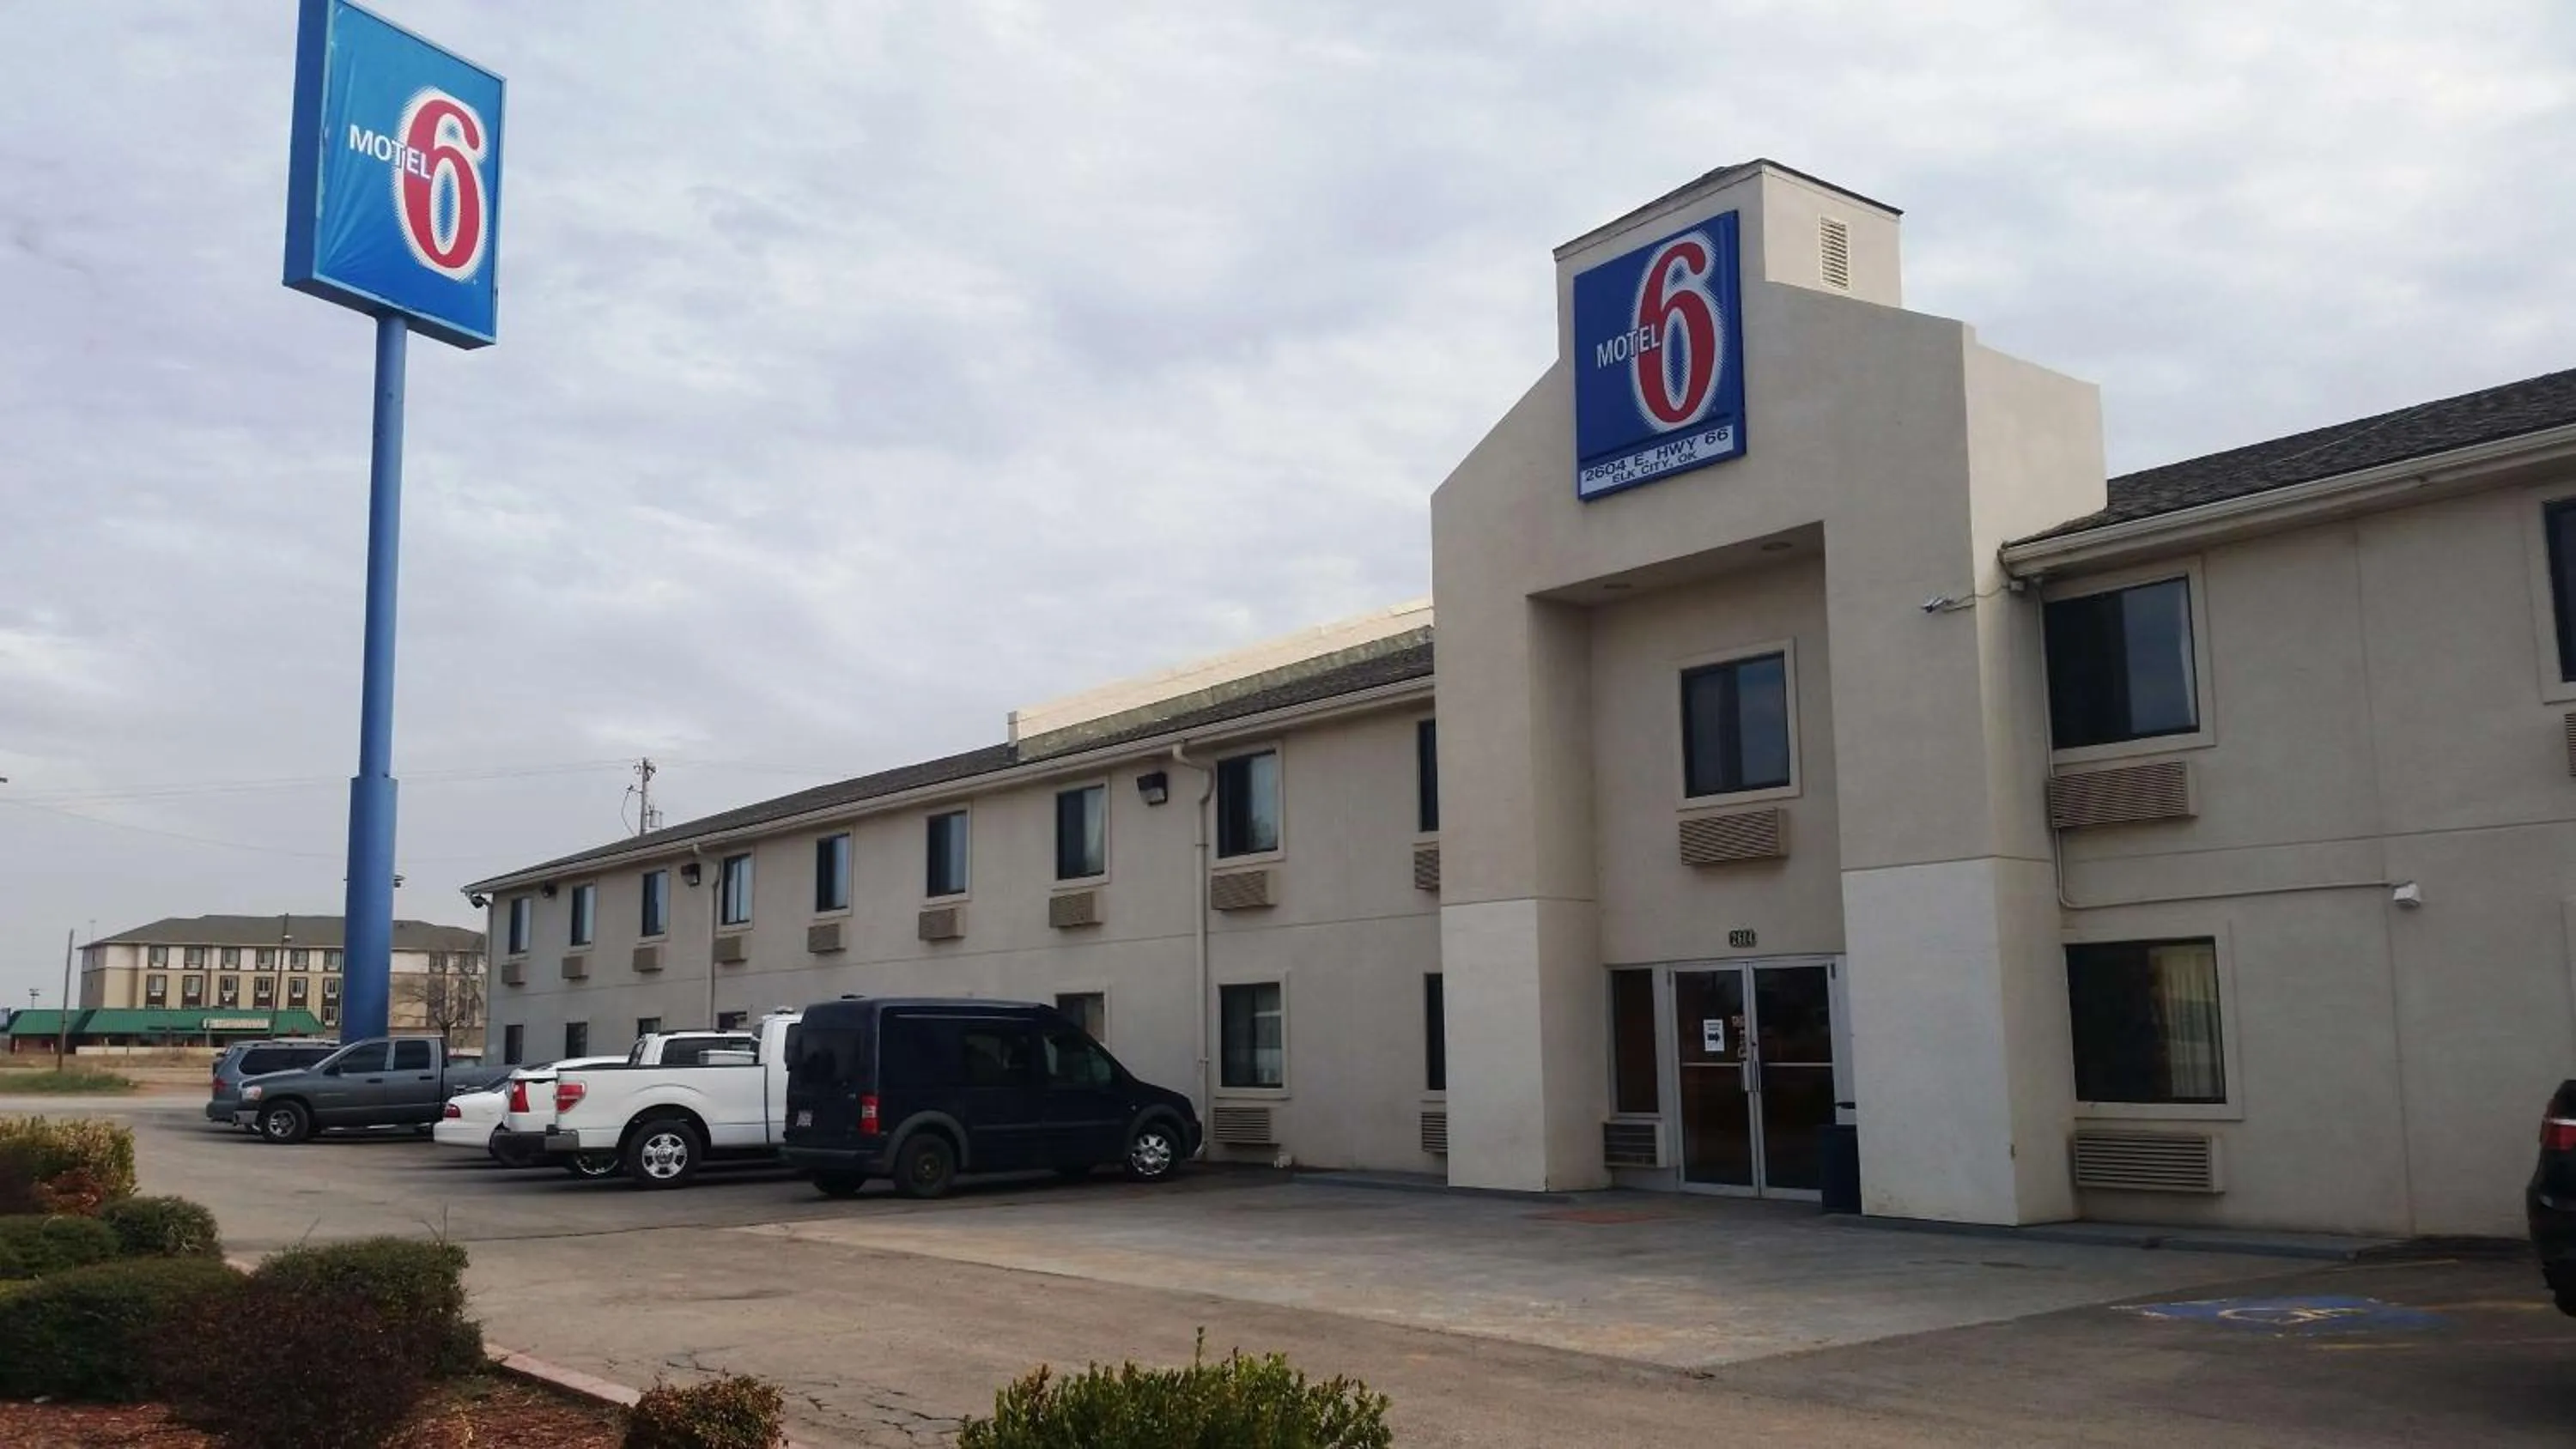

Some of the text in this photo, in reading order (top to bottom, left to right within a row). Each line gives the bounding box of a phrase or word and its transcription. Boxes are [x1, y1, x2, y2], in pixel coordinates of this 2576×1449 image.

[349, 96, 483, 271] MOTEL 6
[1596, 240, 1716, 424] MOTEL 6
[1585, 429, 1728, 482] 2604 E. HWY 66
[1612, 470, 1636, 483] ELK
[1678, 452, 1697, 464] OK
